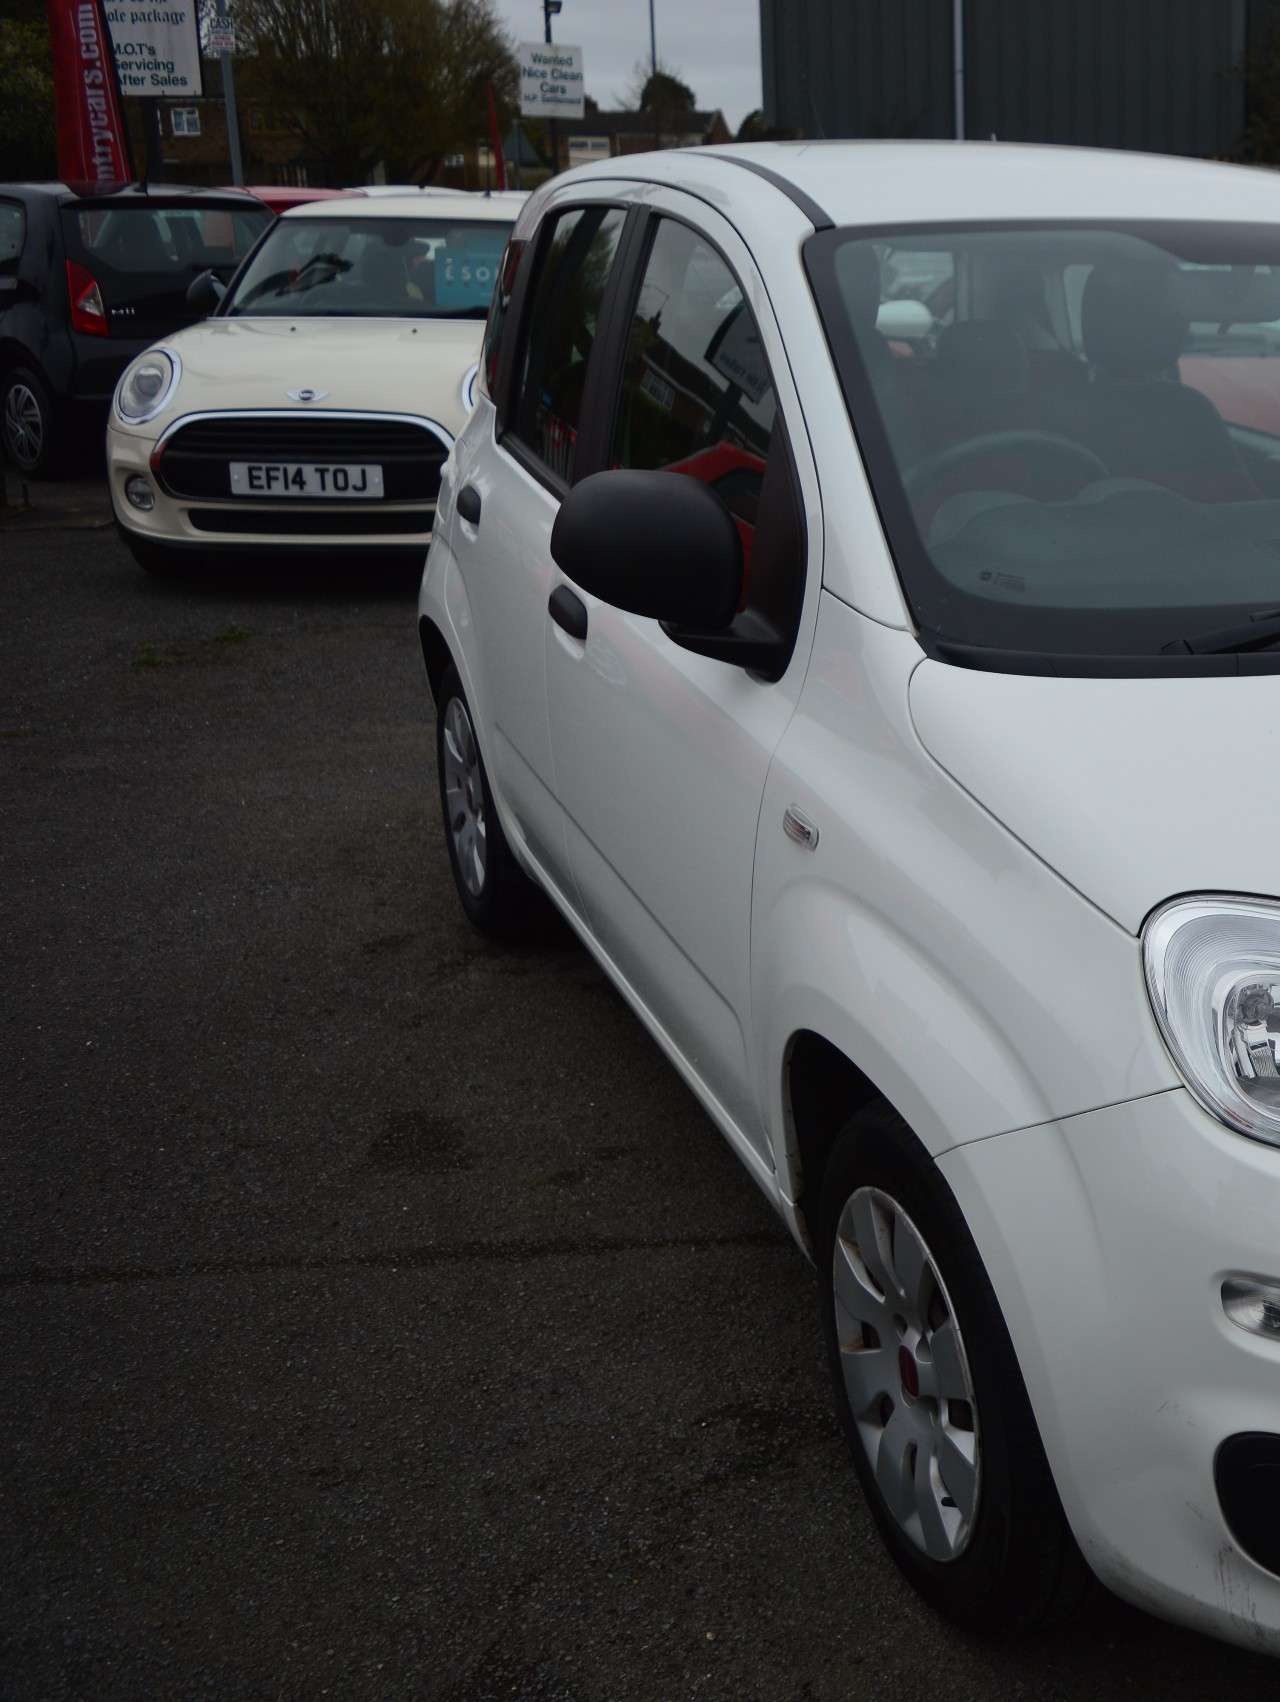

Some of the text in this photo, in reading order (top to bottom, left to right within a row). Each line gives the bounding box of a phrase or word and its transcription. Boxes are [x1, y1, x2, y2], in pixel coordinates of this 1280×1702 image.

[107, 9, 186, 24] ole package
[530, 52, 573, 66] Wanted
[150, 73, 188, 86] Sales
[522, 65, 583, 80] Nice Clean
[78, 3, 114, 180] ntrycars.com
[540, 80, 567, 95] Cars
[248, 466, 367, 492] EF14 TOJ
